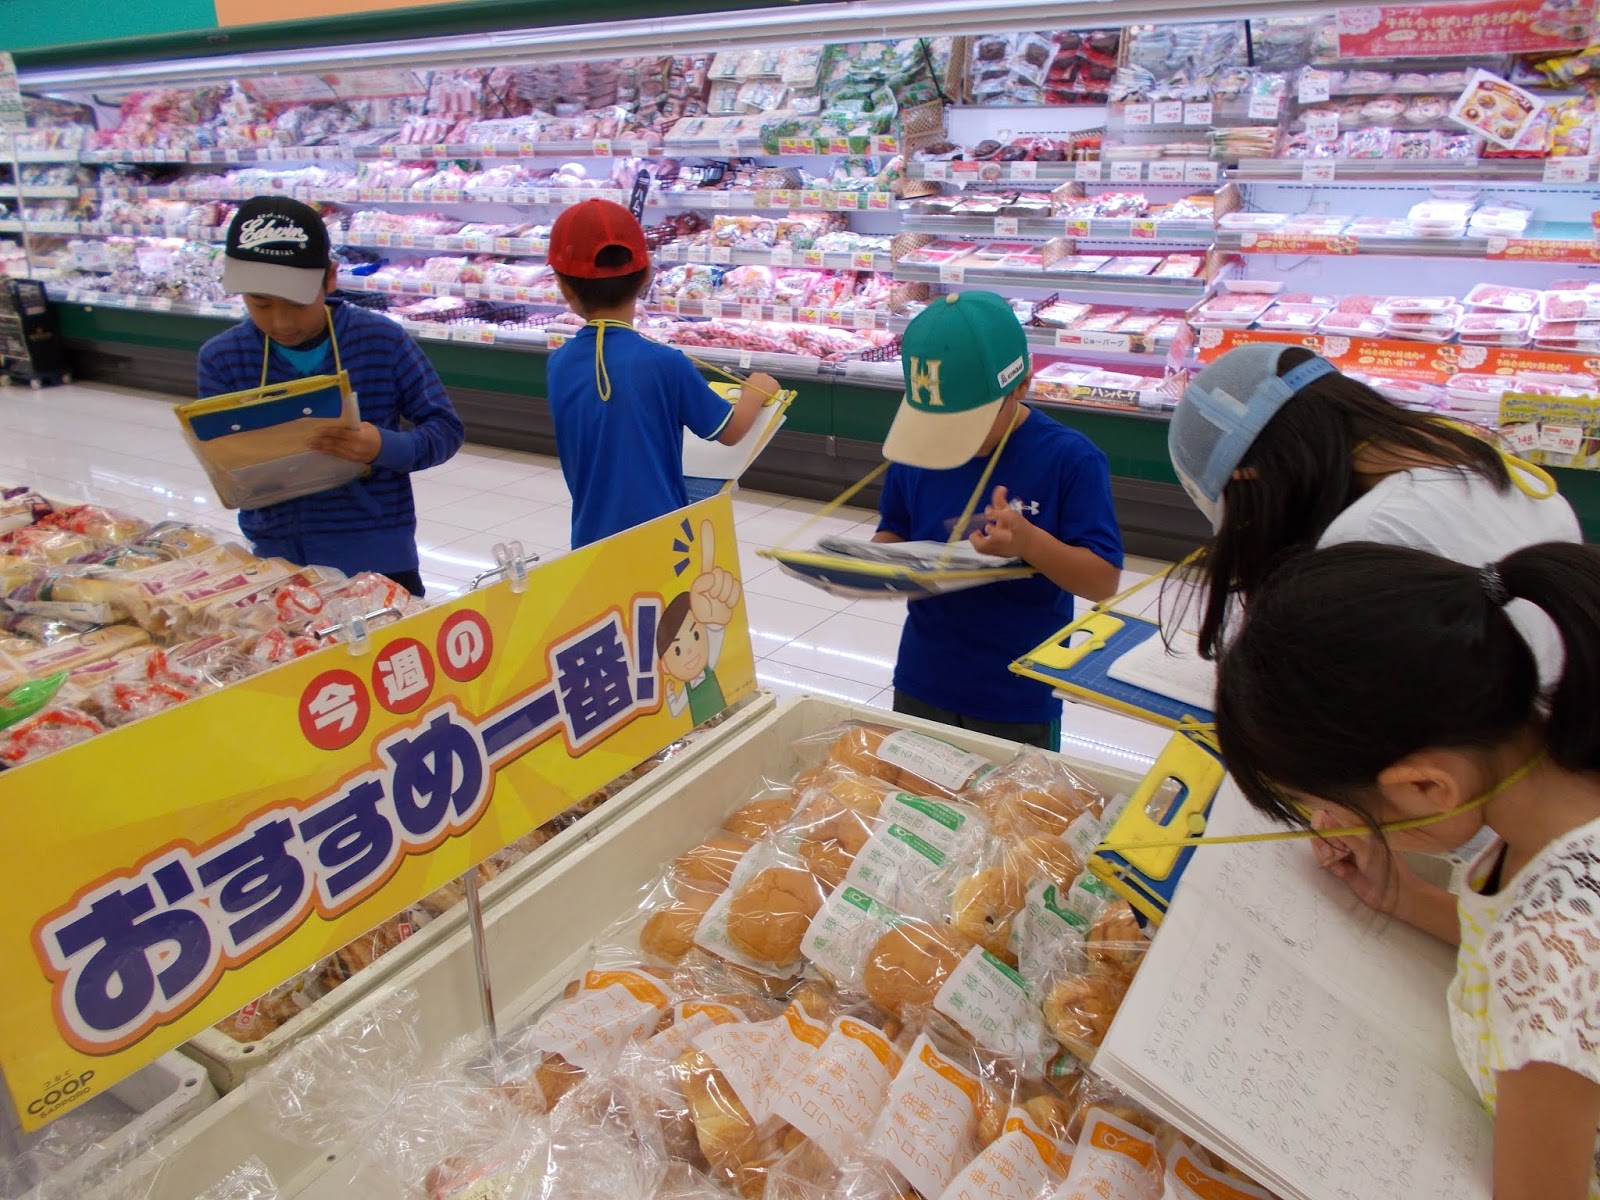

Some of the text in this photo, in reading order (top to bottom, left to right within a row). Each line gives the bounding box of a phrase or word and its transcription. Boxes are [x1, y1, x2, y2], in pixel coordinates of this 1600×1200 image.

[237, 219, 308, 249] Edwin
[253, 246, 295, 256] MATERIAL
[910, 356, 945, 406] H
[1091, 388, 1137, 401] ハンバーグ
[307, 625, 487, 733] 今週の
[713, 1033, 770, 1110] クロワッサン
[27, 1069, 95, 1115] COOP
[40, 1087, 91, 1119] SAPPORO
